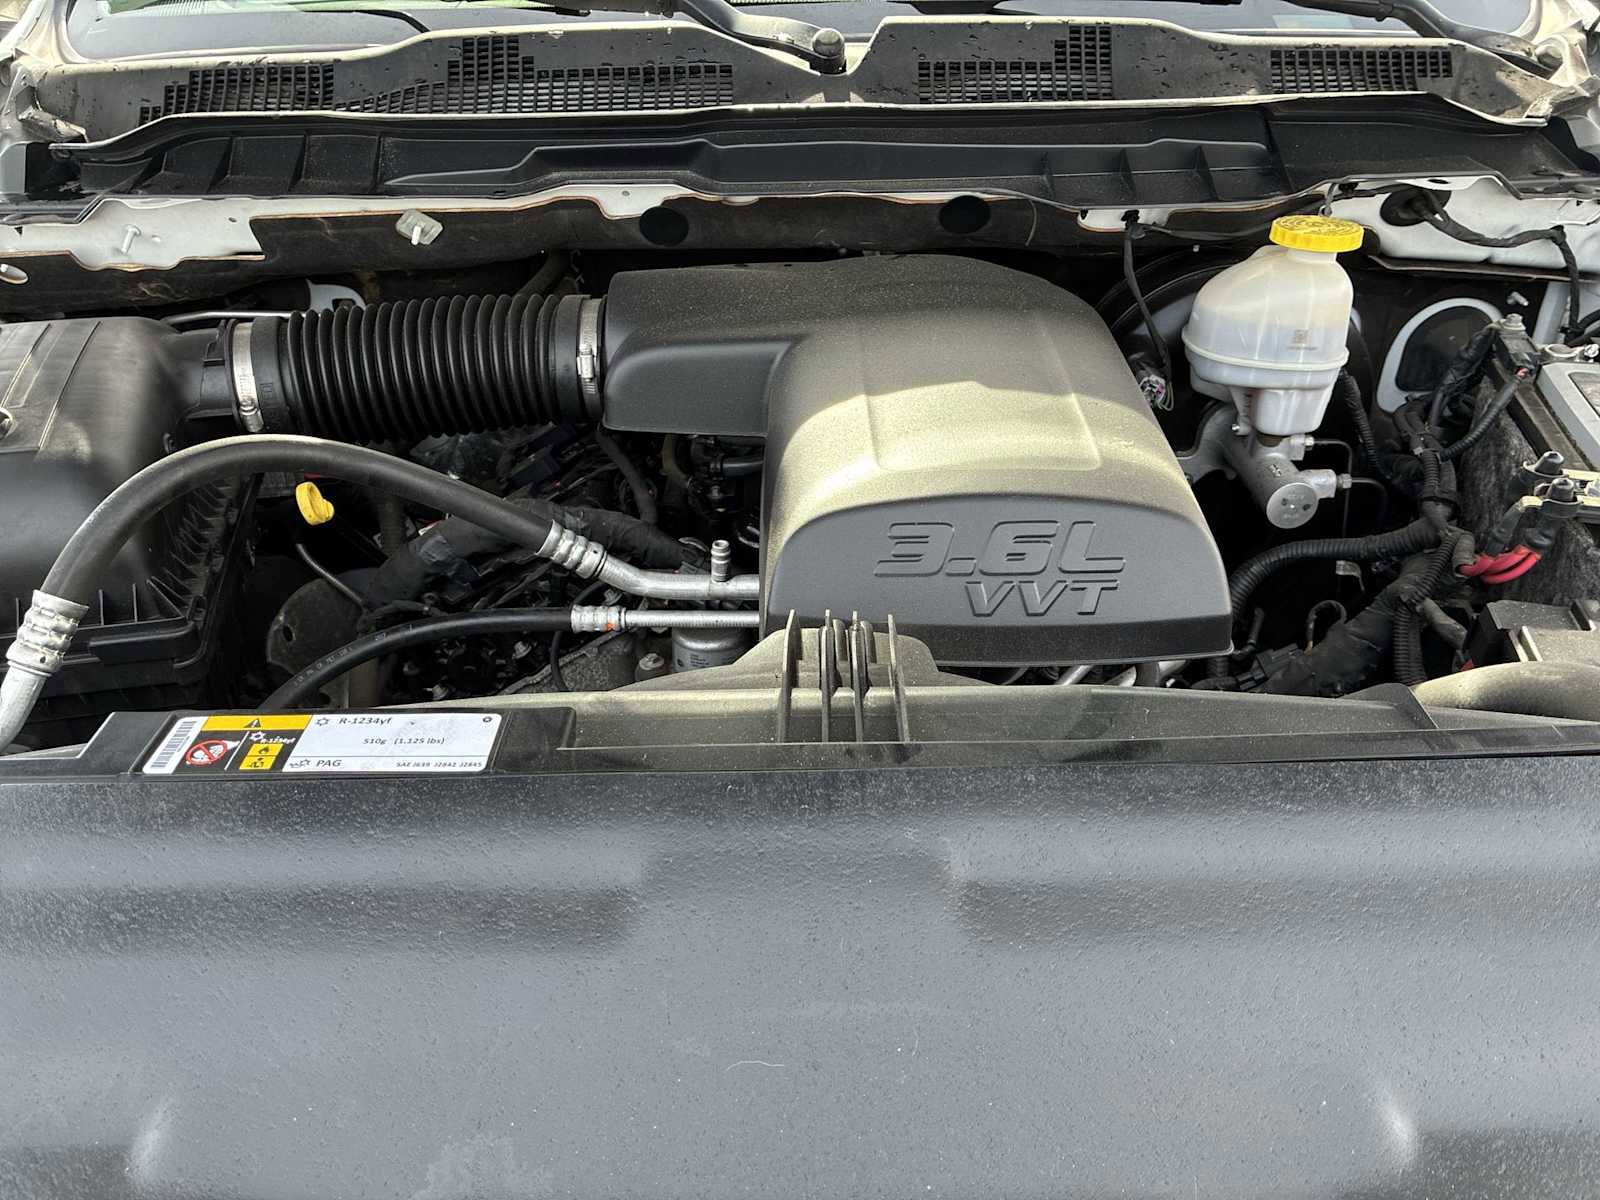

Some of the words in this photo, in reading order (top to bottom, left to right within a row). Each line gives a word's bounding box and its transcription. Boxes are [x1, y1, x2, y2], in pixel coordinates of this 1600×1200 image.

[873, 520, 1126, 577] 3.6L
[964, 579, 1119, 617] VVT
[339, 717, 392, 725] R-1234yf
[427, 737, 445, 745] lbs)
